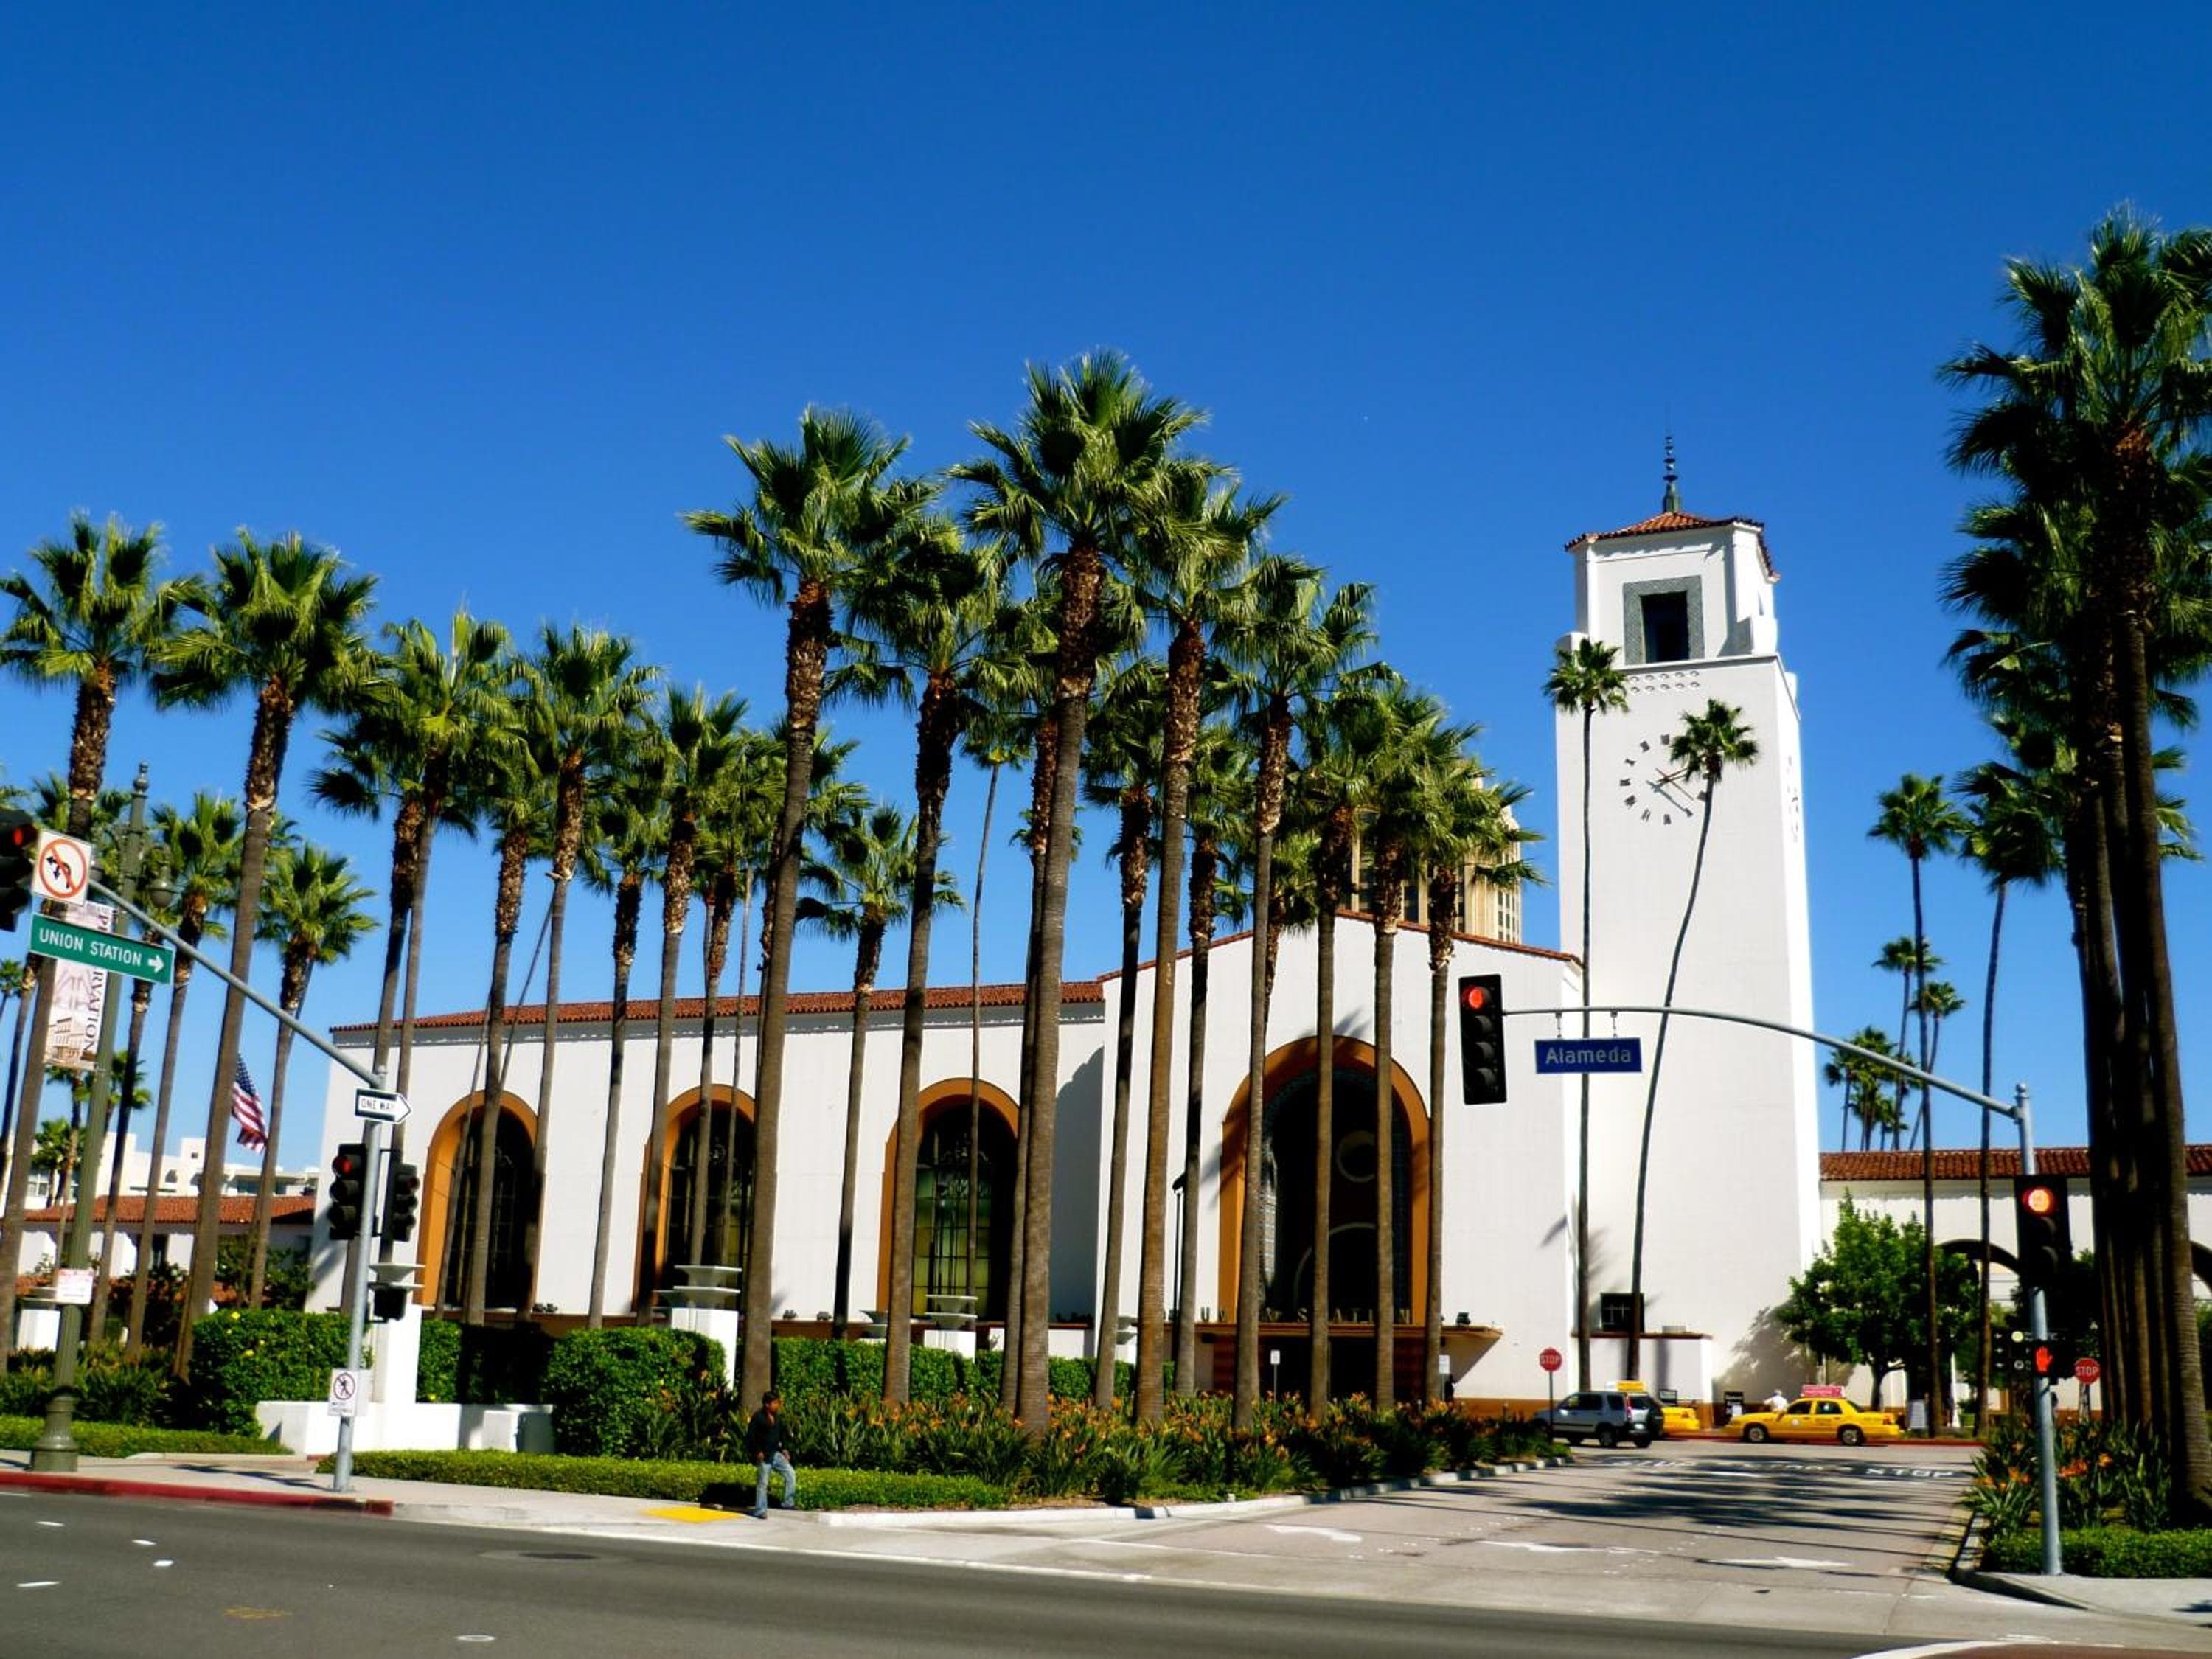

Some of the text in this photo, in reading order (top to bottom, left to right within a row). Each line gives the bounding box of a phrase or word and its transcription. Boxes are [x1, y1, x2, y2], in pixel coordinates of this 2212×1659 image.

[38, 928, 142, 967] UNION STATION
[1545, 1046, 1632, 1064] Alameda
[361, 1098, 377, 1110] ONE
[1297, 1307, 1411, 1324] SATIN
[1540, 1355, 1560, 1364] STOP
[2075, 1366, 2099, 1376] STOP
